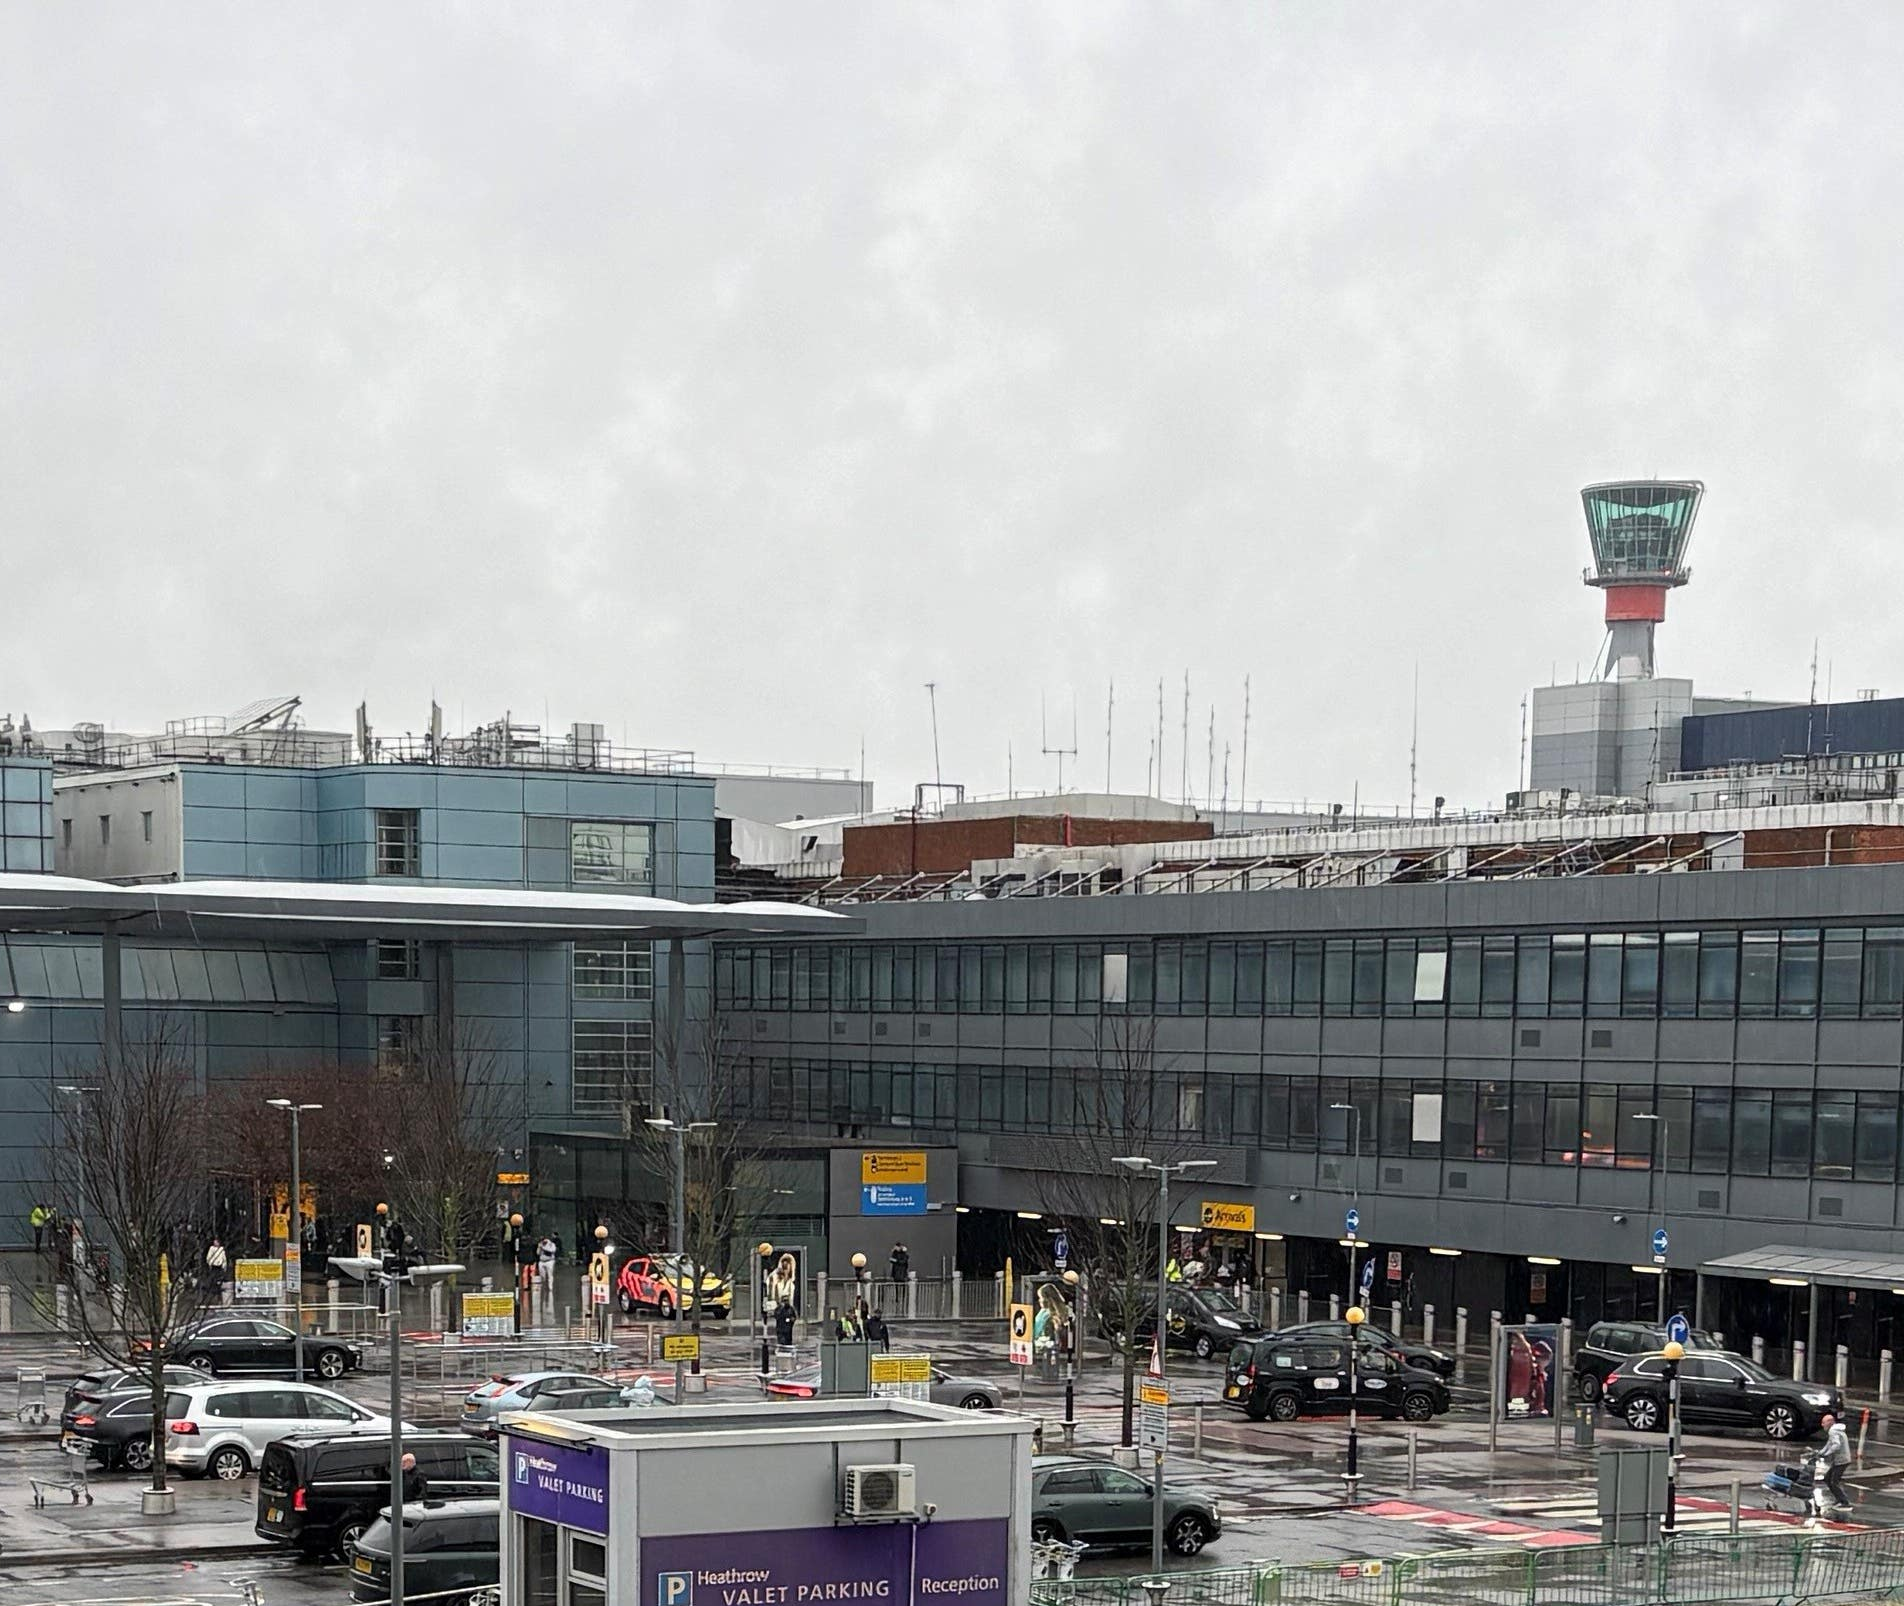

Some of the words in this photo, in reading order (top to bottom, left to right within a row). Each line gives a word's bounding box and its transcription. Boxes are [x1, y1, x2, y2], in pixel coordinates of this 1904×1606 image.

[538, 1474, 564, 1493] VALET
[566, 1481, 604, 1503] PARKING
[697, 1567, 770, 1586] Heathrow
[921, 1575, 1000, 1597] Reception
[722, 1586, 789, 1606] VALET
[797, 1579, 890, 1601] PARKING
